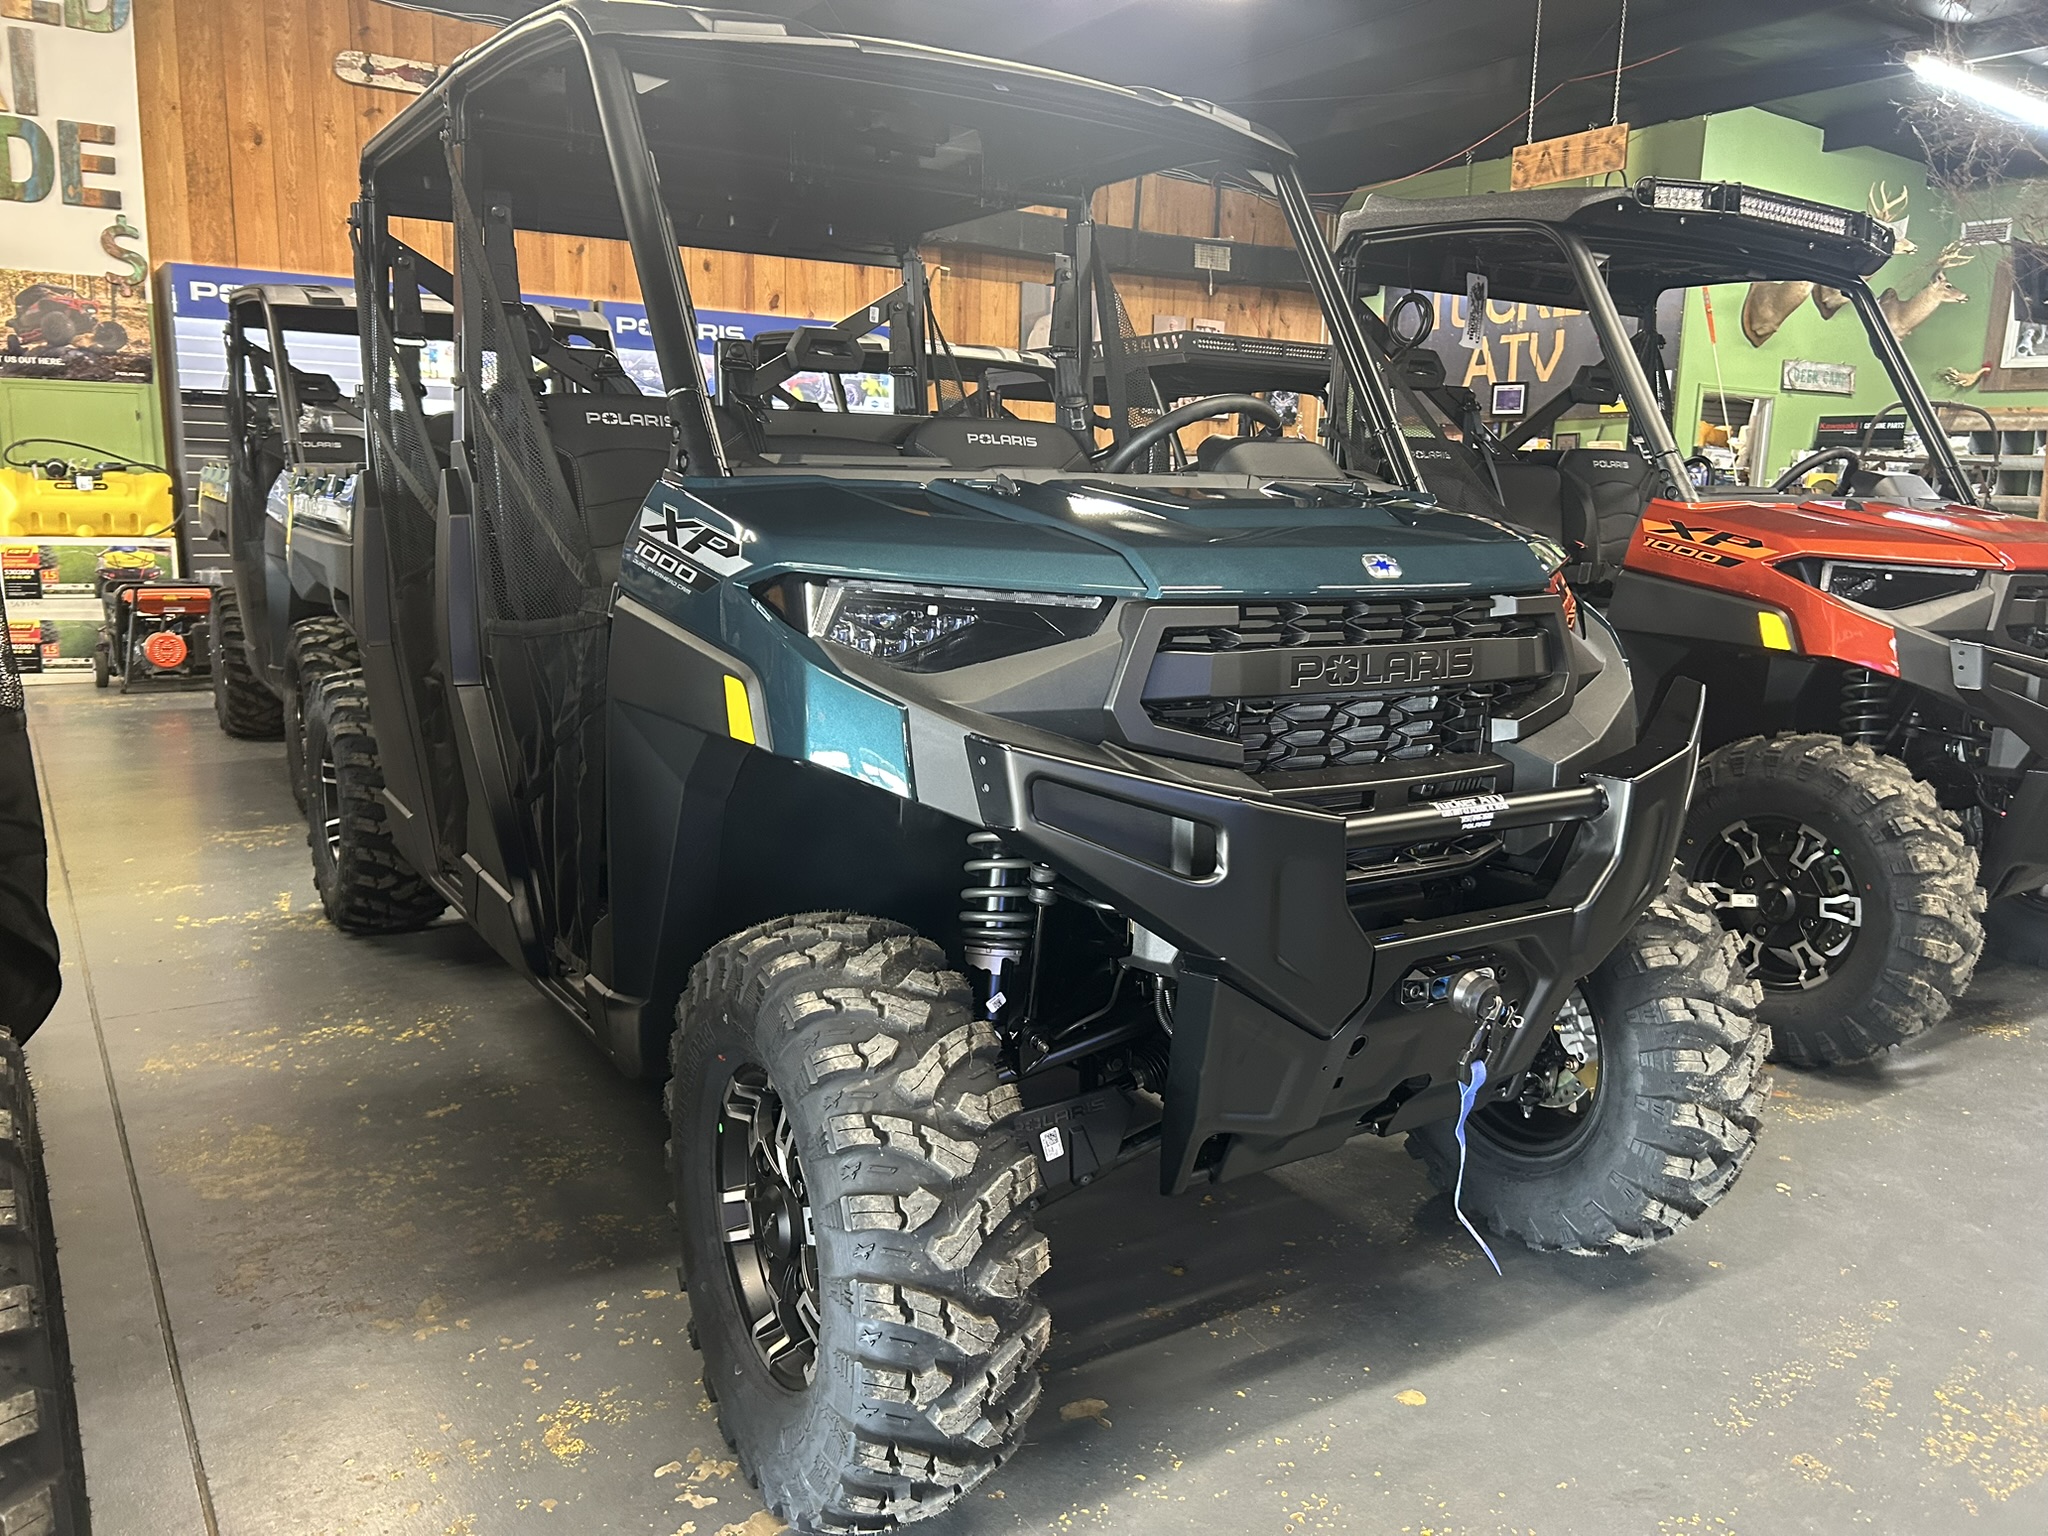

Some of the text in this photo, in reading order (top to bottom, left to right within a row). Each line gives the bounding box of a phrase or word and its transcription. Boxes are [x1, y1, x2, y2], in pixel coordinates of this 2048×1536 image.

[616, 316, 746, 341] PORIS
[4, 355, 17, 363] US
[18, 356, 37, 364] OUT
[1462, 329, 1565, 387] ATV
[1863, 422, 1886, 430] GEINE
[299, 441, 342, 449] OLARIS
[967, 433, 1037, 447] POLARIS
[1593, 460, 1629, 469] POLARIS
[640, 503, 741, 558] XP
[1647, 519, 1763, 549] XP
[1643, 537, 1722, 563] 1000
[634, 540, 698, 584] 1000
[43, 571, 57, 579] 15
[677, 583, 692, 595] CAM
[44, 645, 57, 654] 15
[1290, 648, 1475, 688] POLARIS
